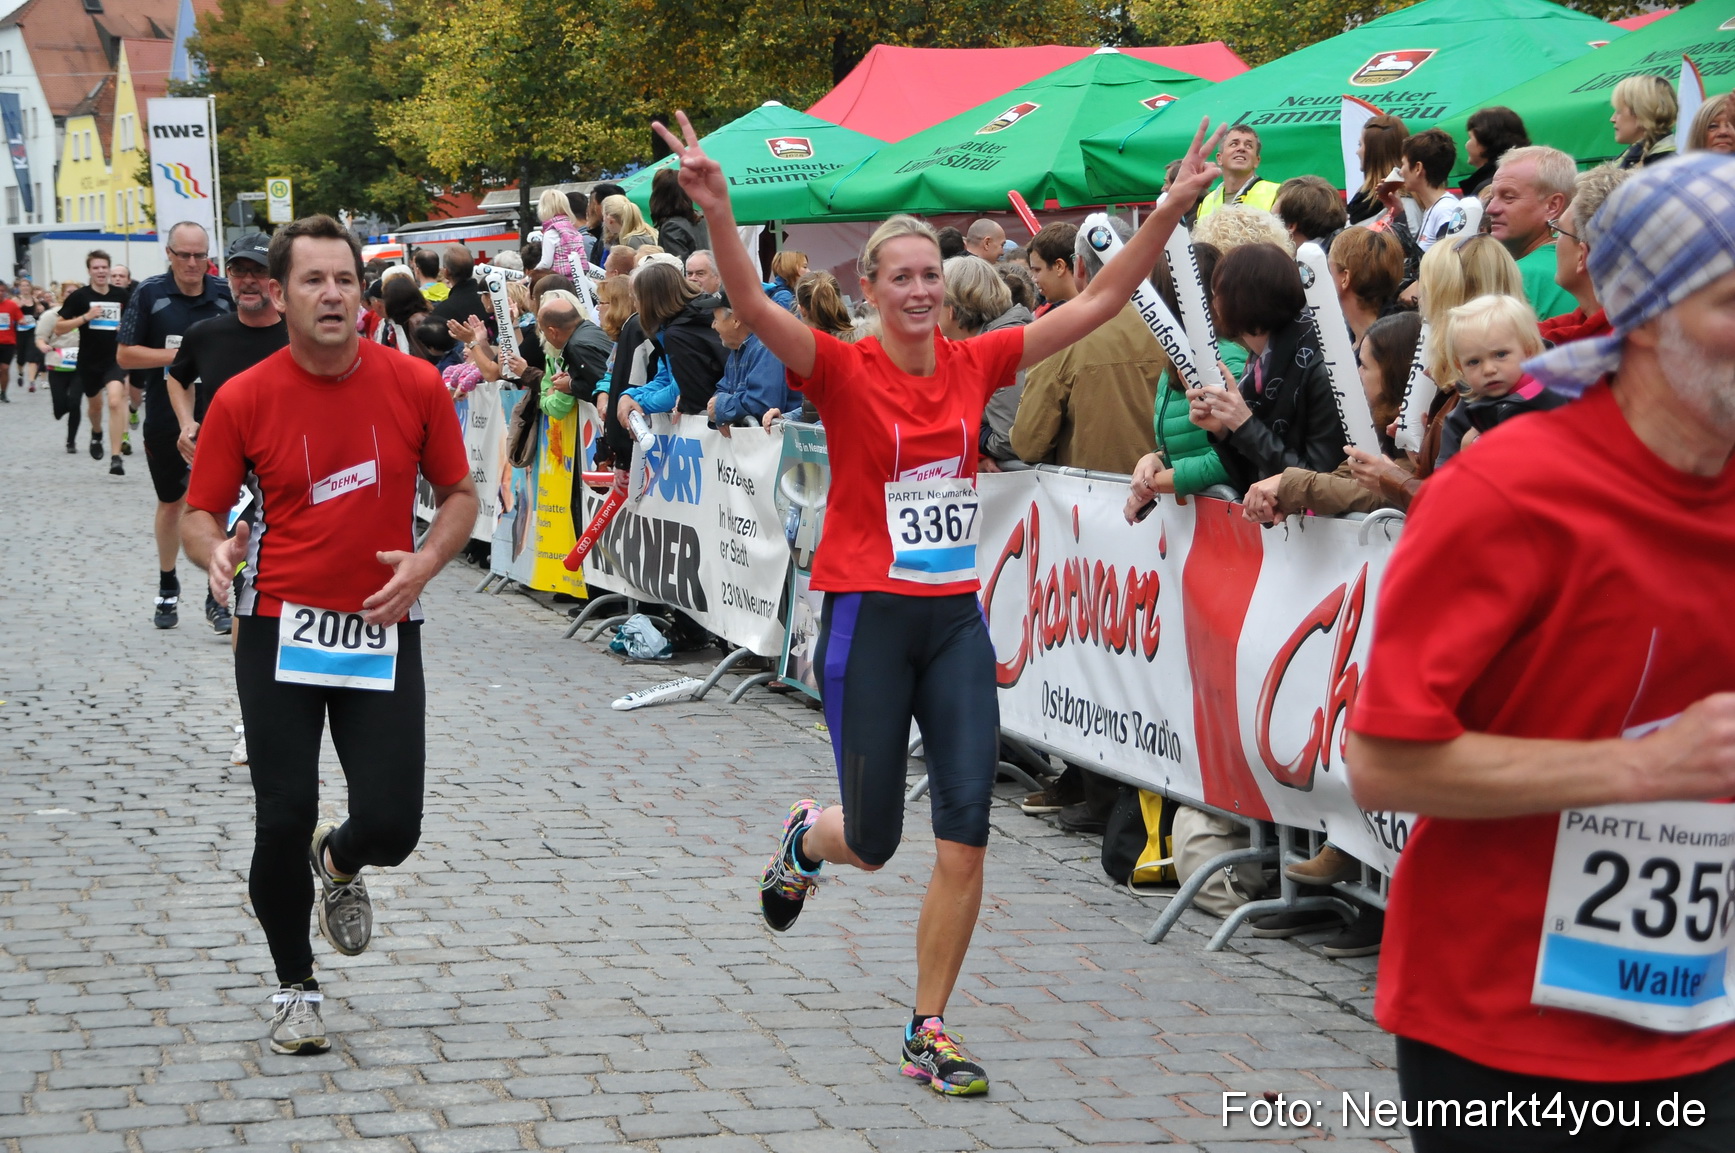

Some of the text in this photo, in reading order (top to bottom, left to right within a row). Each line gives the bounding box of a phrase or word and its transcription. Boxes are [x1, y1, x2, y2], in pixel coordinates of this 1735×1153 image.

[746, 163, 844, 175] Neumarkte
[330, 472, 359, 492] DEHN
[916, 466, 943, 482] DEHN
[888, 488, 972, 502] PARTL Neumarkt
[591, 500, 617, 534] Audi BKK
[899, 502, 979, 545] 3367
[980, 500, 1167, 689] Charivari
[292, 608, 388, 649] 2009
[1041, 680, 1182, 764] Ostbayerns Radio
[1565, 810, 1651, 842] PARTL
[1555, 918, 1565, 932] B
